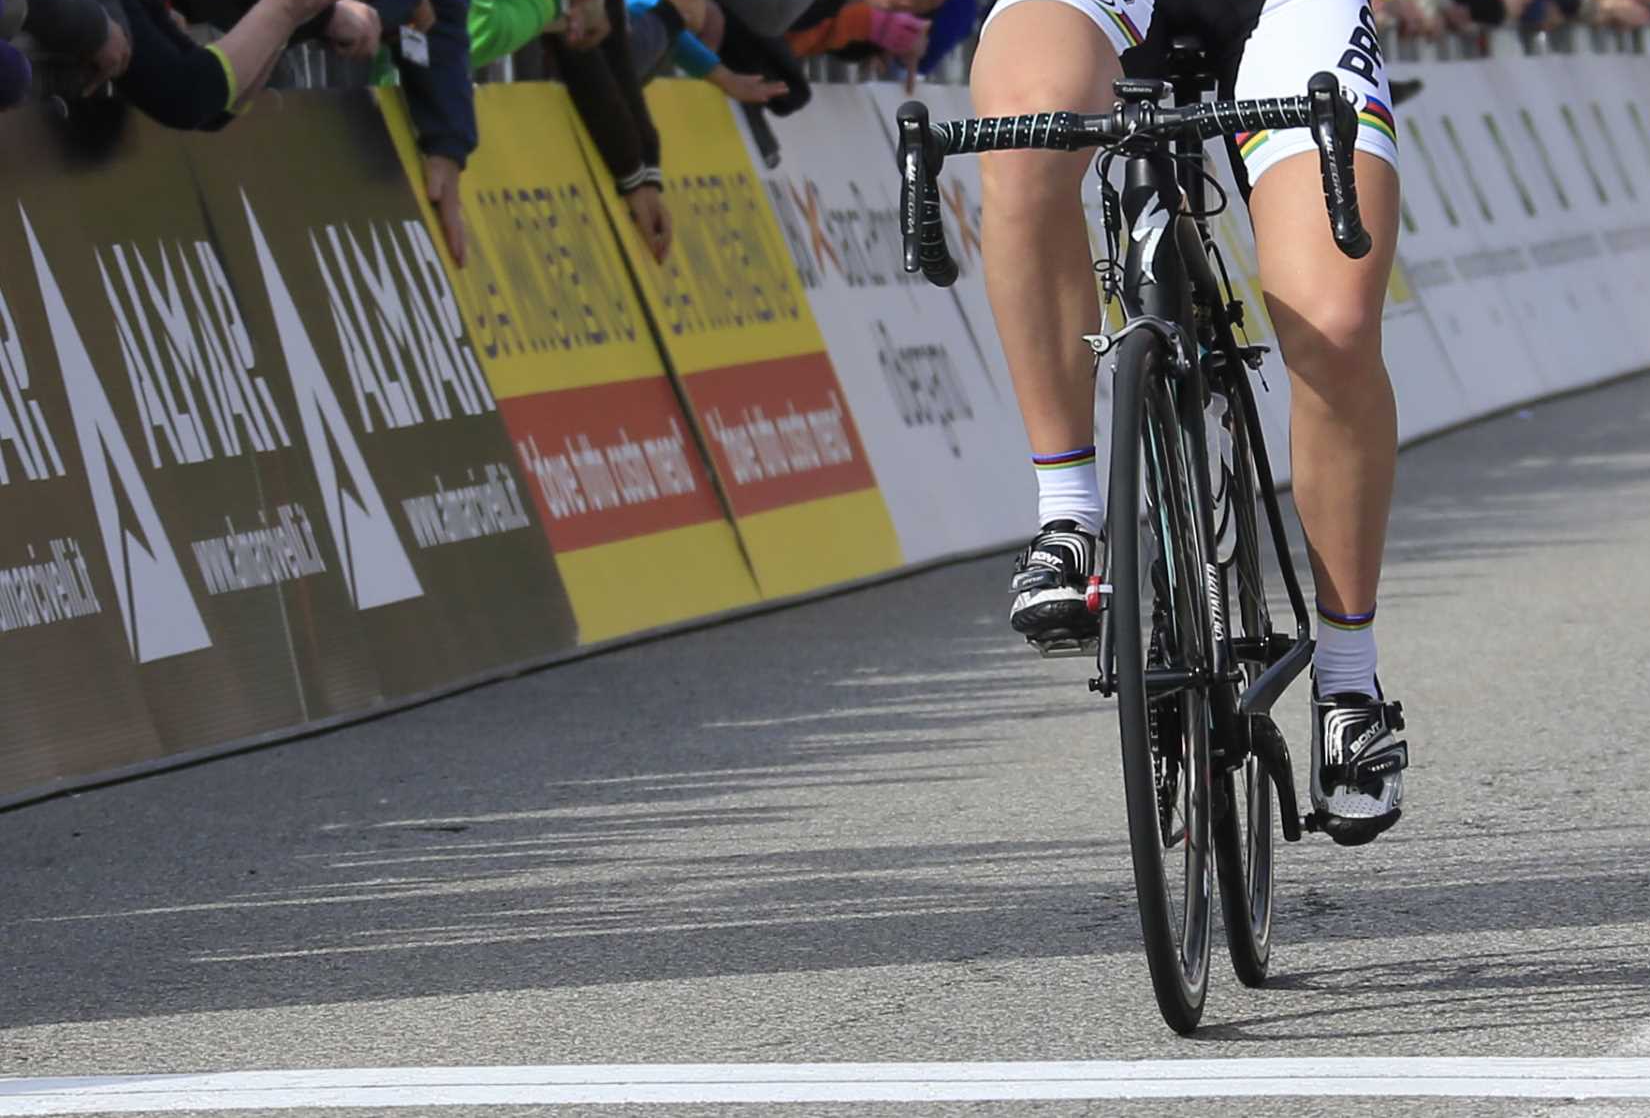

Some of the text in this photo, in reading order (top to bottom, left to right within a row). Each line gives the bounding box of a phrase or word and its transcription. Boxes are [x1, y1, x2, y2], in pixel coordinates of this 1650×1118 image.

[1326, 136, 1346, 206] ULTEGRA
[1030, 550, 1064, 565] BONT
[1348, 720, 1382, 754] BONT
